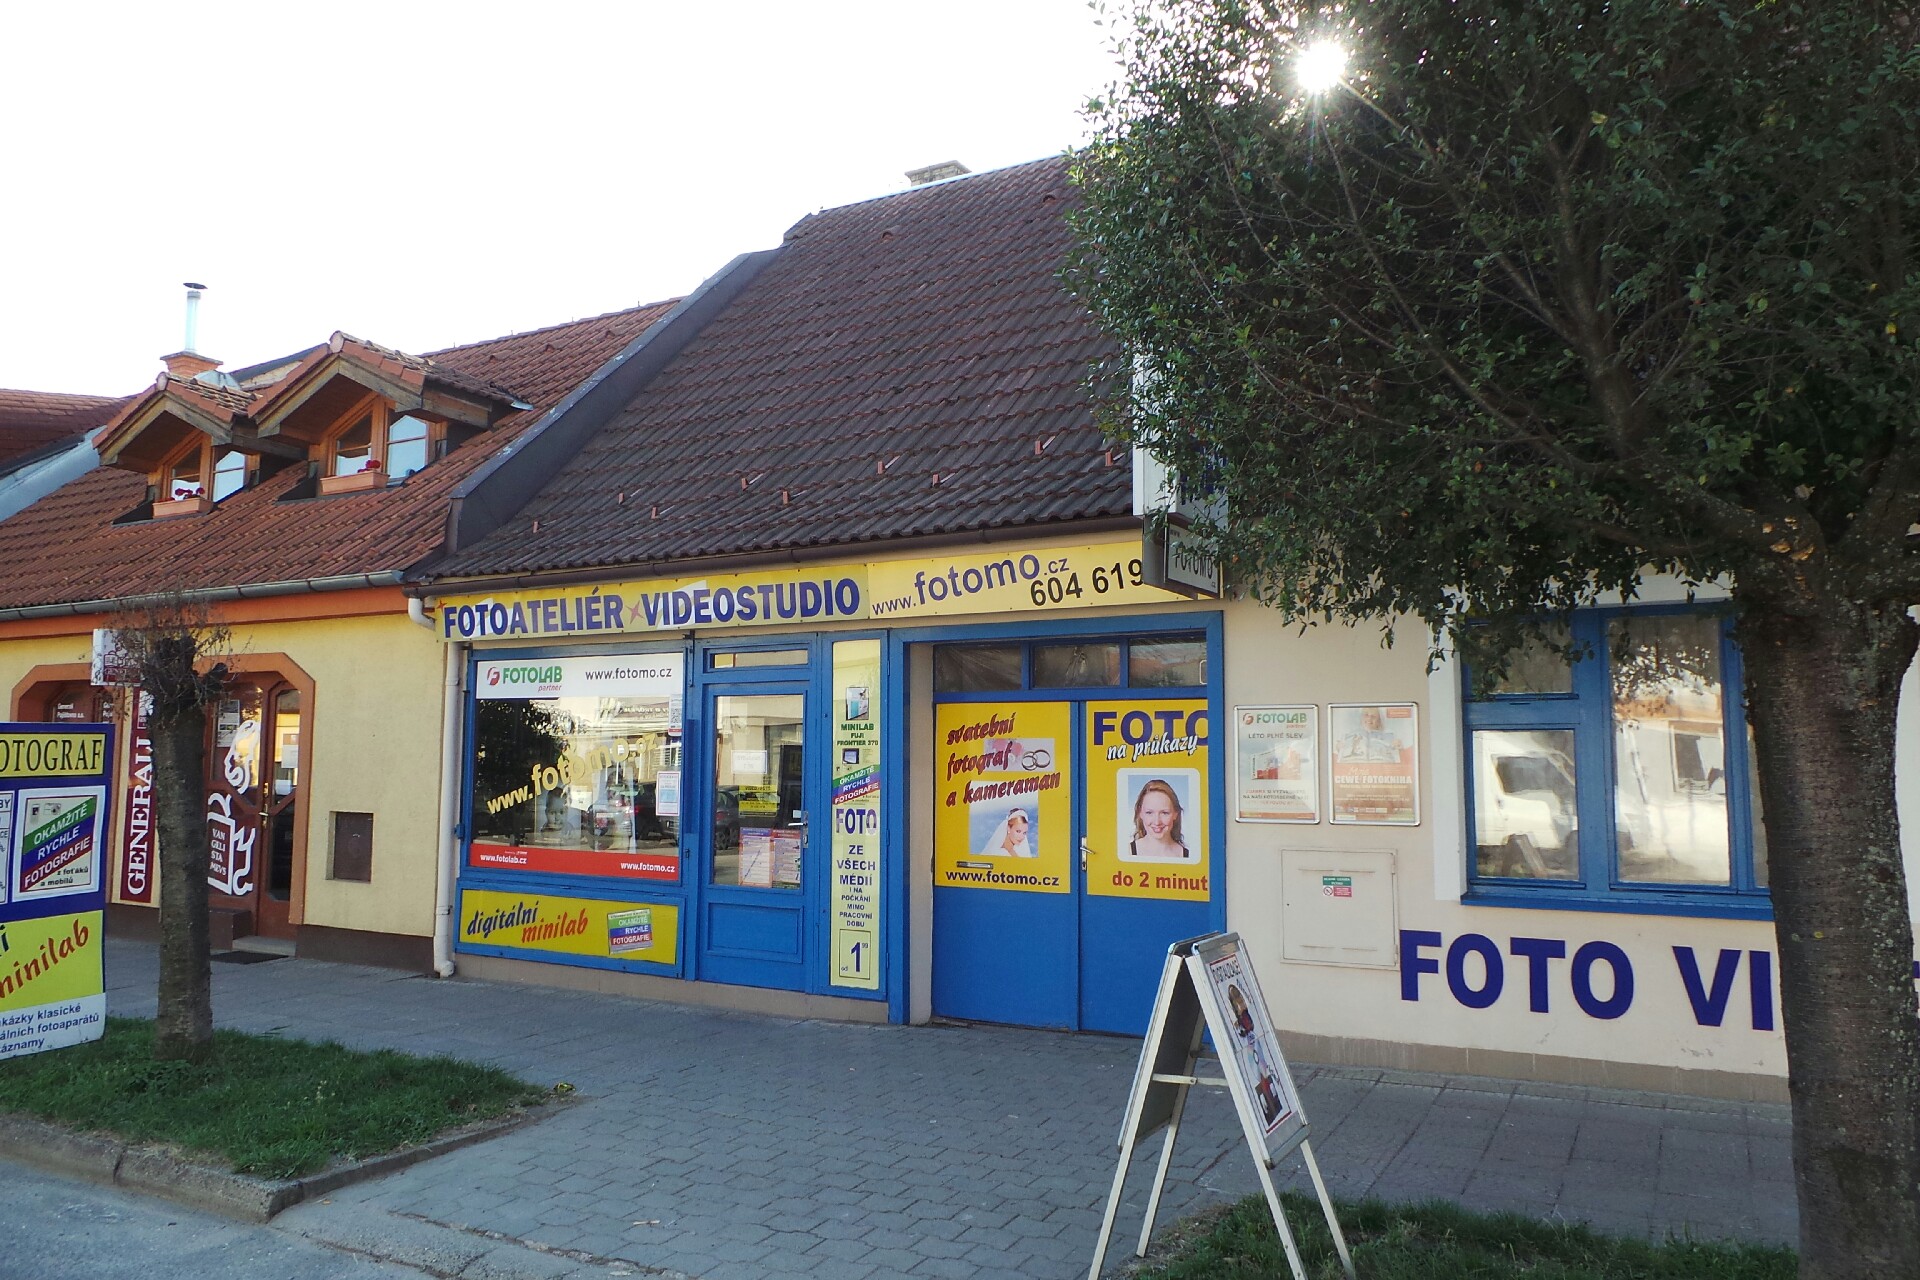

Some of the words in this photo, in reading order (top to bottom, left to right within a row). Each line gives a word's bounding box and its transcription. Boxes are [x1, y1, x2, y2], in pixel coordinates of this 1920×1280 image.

[1030, 573, 1083, 606] 604
[1092, 558, 1143, 594] 619
[444, 587, 624, 638] FOTOATELIÉR
[640, 578, 860, 626] VIDEOSTUDIO
[503, 666, 563, 684] FOTOLAB
[585, 667, 672, 680] www.fotomo.cz
[1093, 710, 1208, 747] FOTO
[1256, 713, 1307, 724] FOTOLAB
[946, 712, 1016, 746] svatební
[1107, 745, 1126, 761] na
[1133, 733, 1198, 761] průkazy
[947, 742, 1012, 781] fotograf
[486, 733, 657, 815] www.fotomo.cz
[842, 776, 871, 792] RYCHLE
[834, 782, 879, 804] FOTOGRAFIE
[946, 793, 957, 807] a
[963, 771, 1060, 804] kameraman
[128, 736, 154, 894] GENERALI
[836, 808, 877, 835] FOTO
[38, 826, 80, 860] RYCHLE
[849, 845, 864, 855] ZE
[24, 836, 91, 888] FOTOGRAFIE
[211, 852, 223, 863] STA
[480, 854, 527, 864] www.fotolab.cz
[620, 861, 676, 873] www.fotomo.cz
[837, 858, 876, 871] VŠECH
[48, 876, 73, 886] mobilů
[839, 873, 872, 886] MÉDIÍ
[946, 871, 1060, 887] www.fotomo.cz
[1112, 871, 1134, 887] do
[1139, 872, 1150, 888] 2
[1155, 873, 1208, 891] minut
[841, 894, 871, 903] POČKÁNÍ
[847, 903, 865, 911] MIMO
[467, 901, 540, 939] digitální
[839, 911, 873, 920] PRACOVNÍ
[521, 908, 589, 944] minilab
[625, 925, 649, 935] RYCHLE
[612, 934, 650, 945] FOTOGRAFIE
[1400, 929, 1634, 1020] FOTO
[0, 1013, 34, 1027] kázky
[38, 1003, 81, 1021] klasické
[37, 1013, 100, 1034] fotoaparátů
